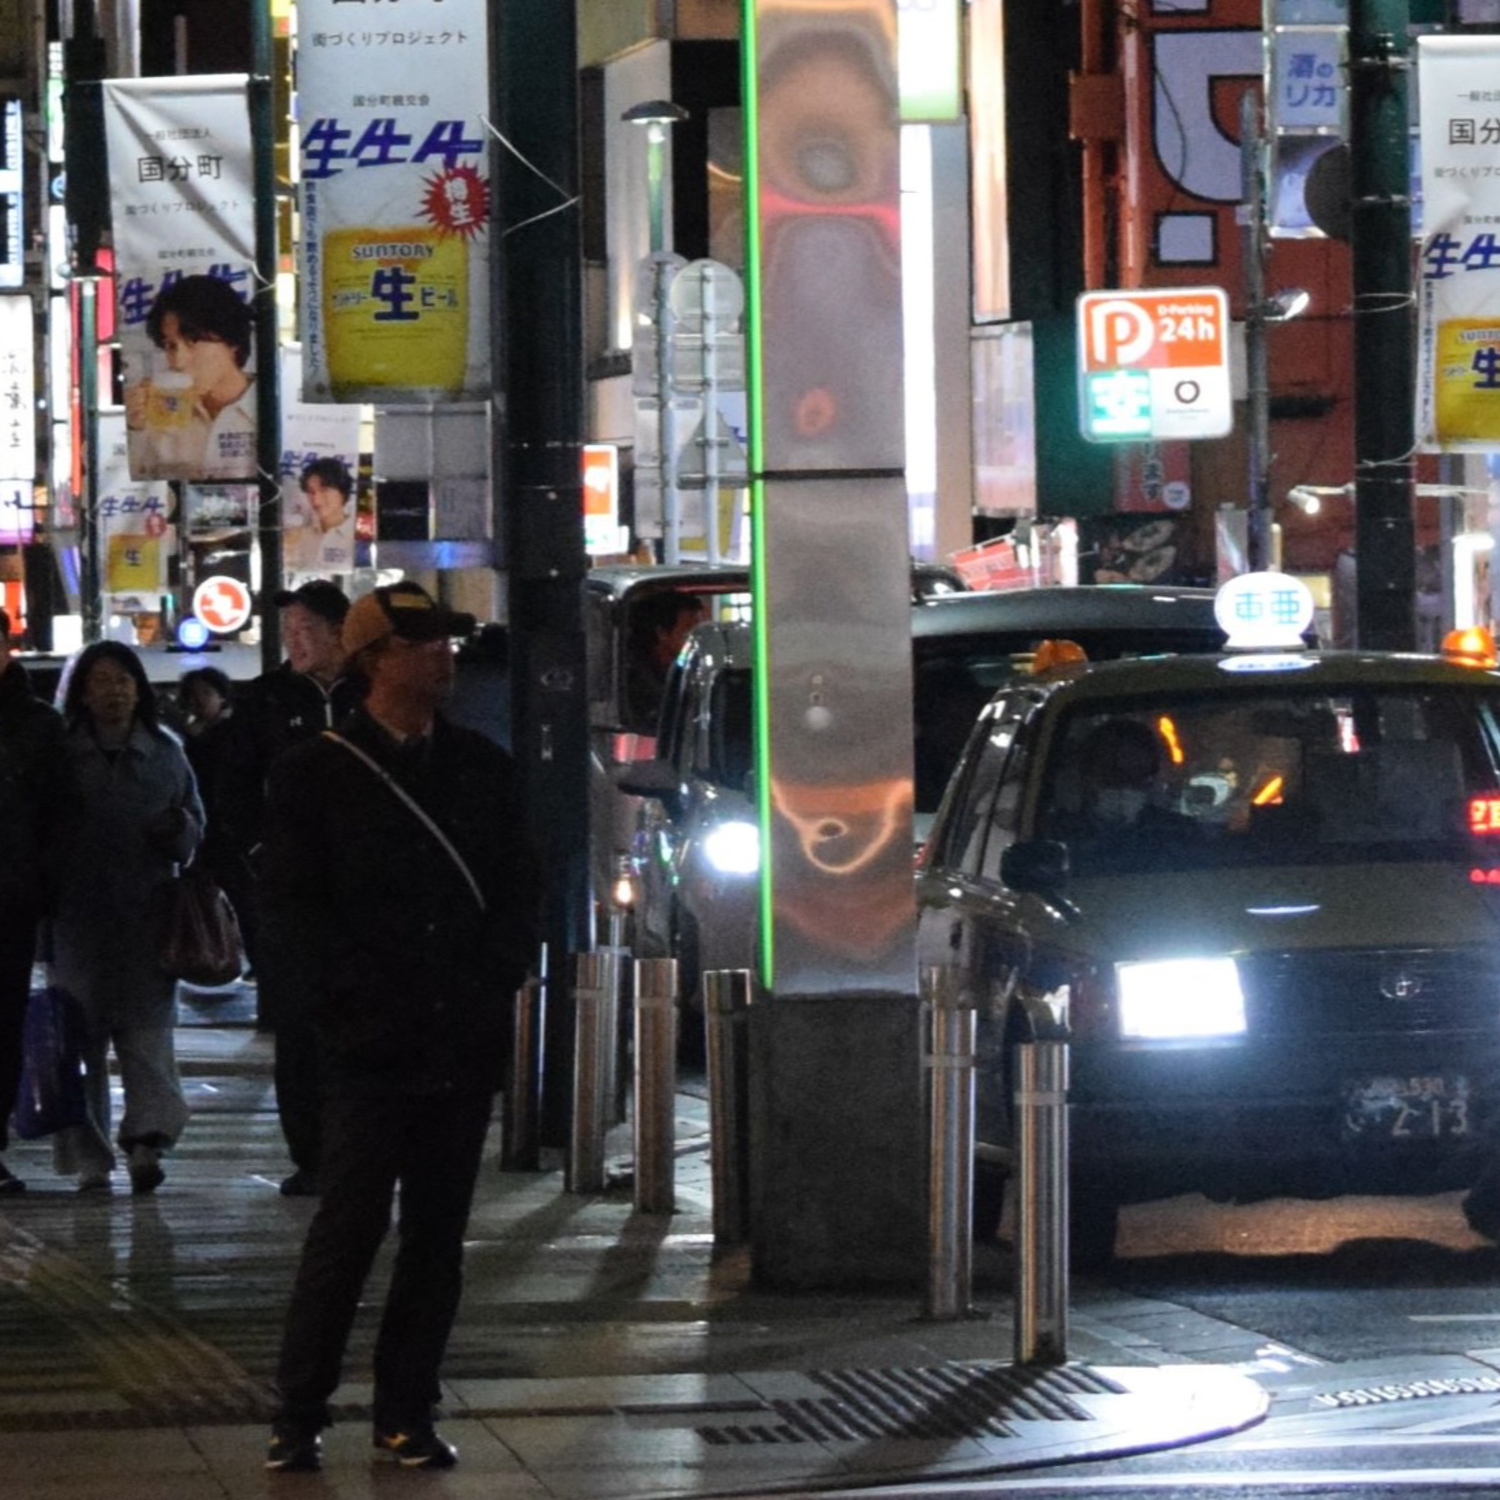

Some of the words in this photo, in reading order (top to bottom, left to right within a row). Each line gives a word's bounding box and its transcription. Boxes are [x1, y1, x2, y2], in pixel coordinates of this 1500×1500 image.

[312, 30, 468, 47] 街づくりプロジェクト
[138, 155, 223, 183] 国分町
[371, 266, 420, 321] 生
[1159, 316, 1215, 342] 24h
